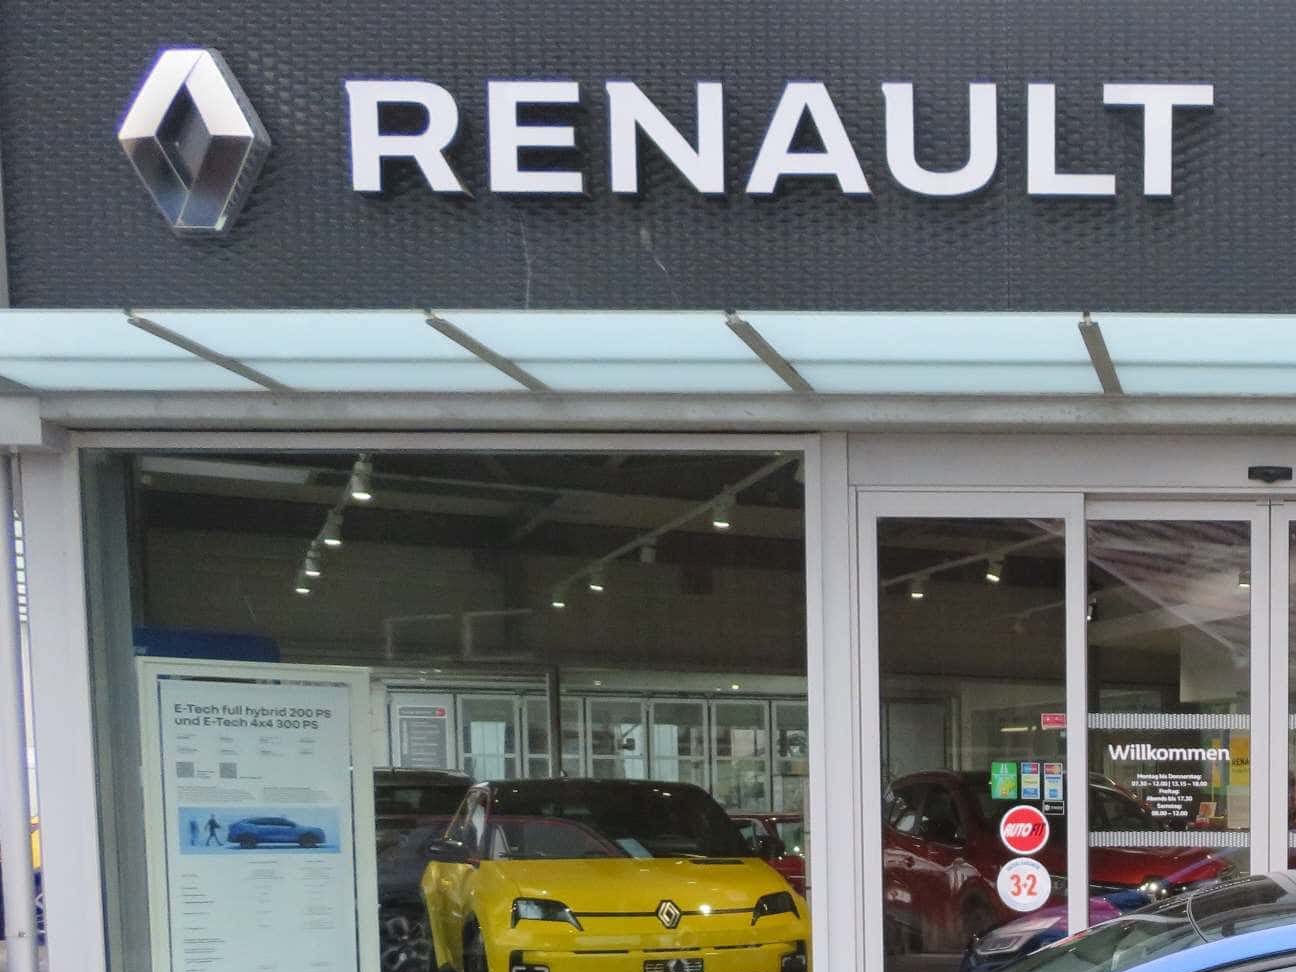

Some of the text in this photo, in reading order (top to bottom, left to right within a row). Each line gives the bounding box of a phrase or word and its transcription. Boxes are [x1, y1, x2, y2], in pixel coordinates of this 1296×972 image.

[345, 80, 1214, 196] RENAULT
[174, 703, 332, 719] E-Tech full hybrid 200 PS
[175, 716, 320, 730] und E-Tech 4x4 300 PS
[1108, 743, 1230, 761] Willkommen
